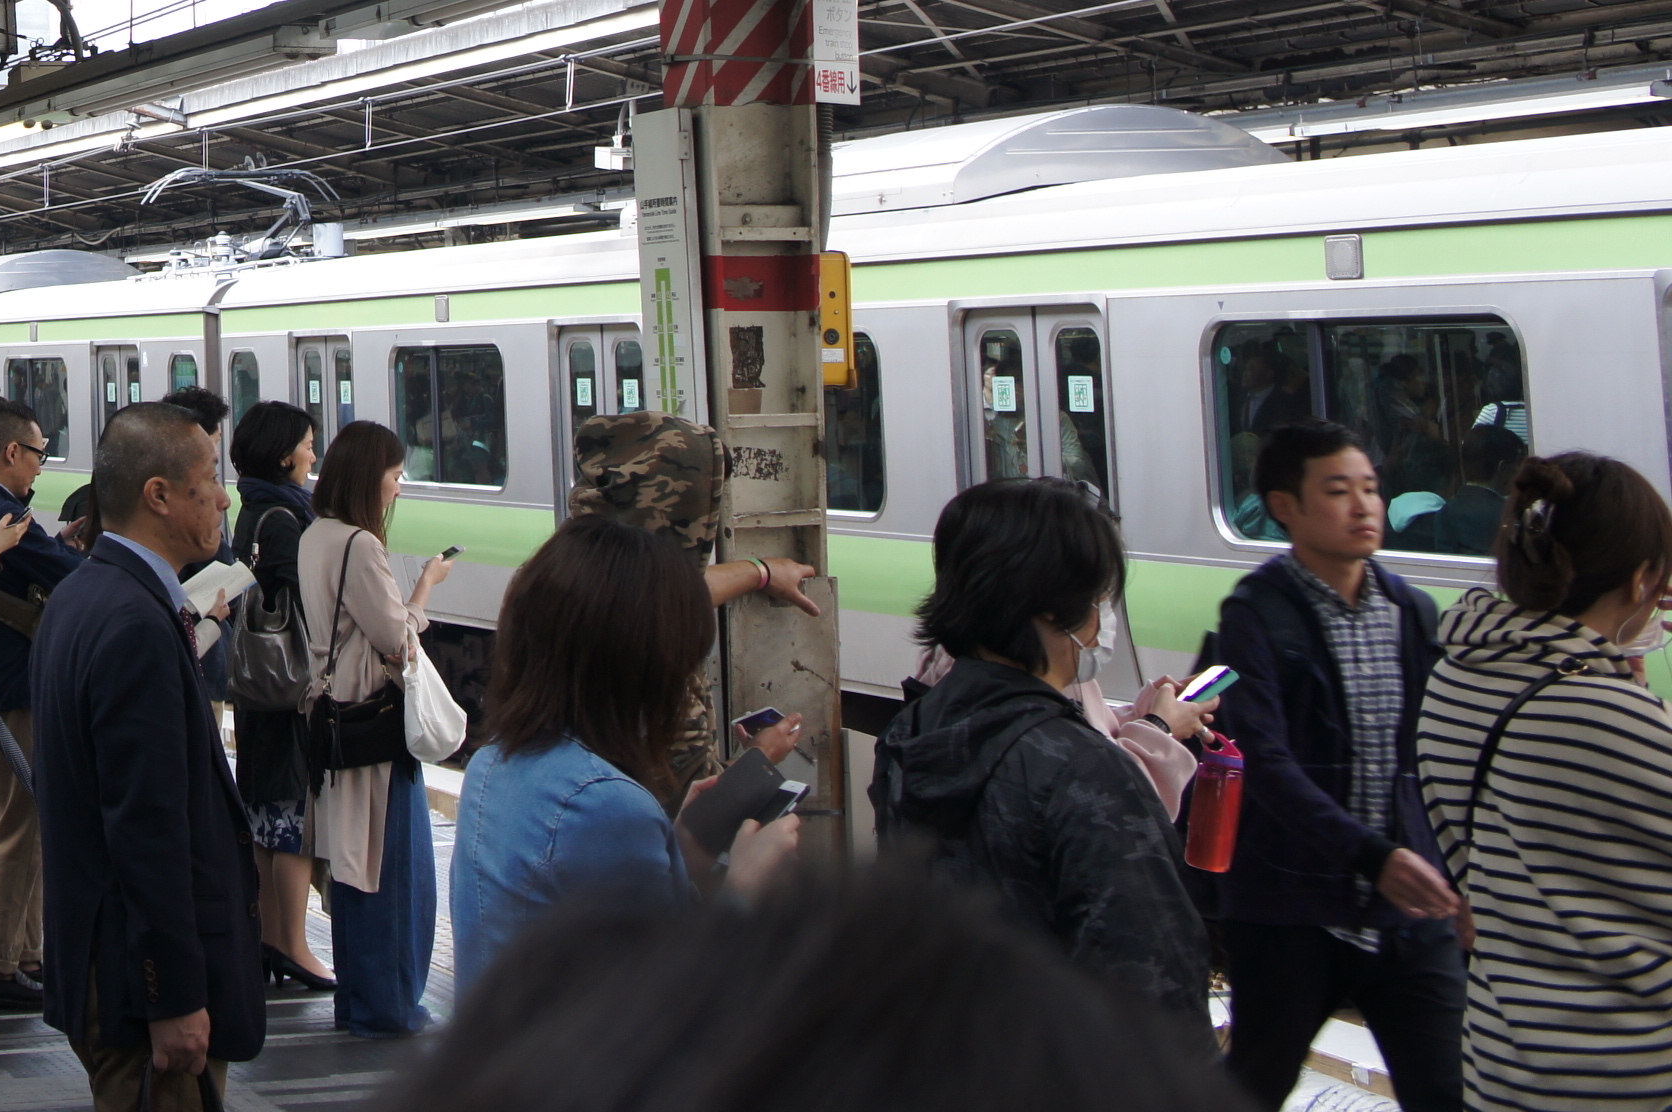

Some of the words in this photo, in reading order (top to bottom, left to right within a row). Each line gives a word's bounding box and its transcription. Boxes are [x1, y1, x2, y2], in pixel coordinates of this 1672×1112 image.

[825, 7, 852, 22] ボタン
[818, 26, 852, 39] Emergency
